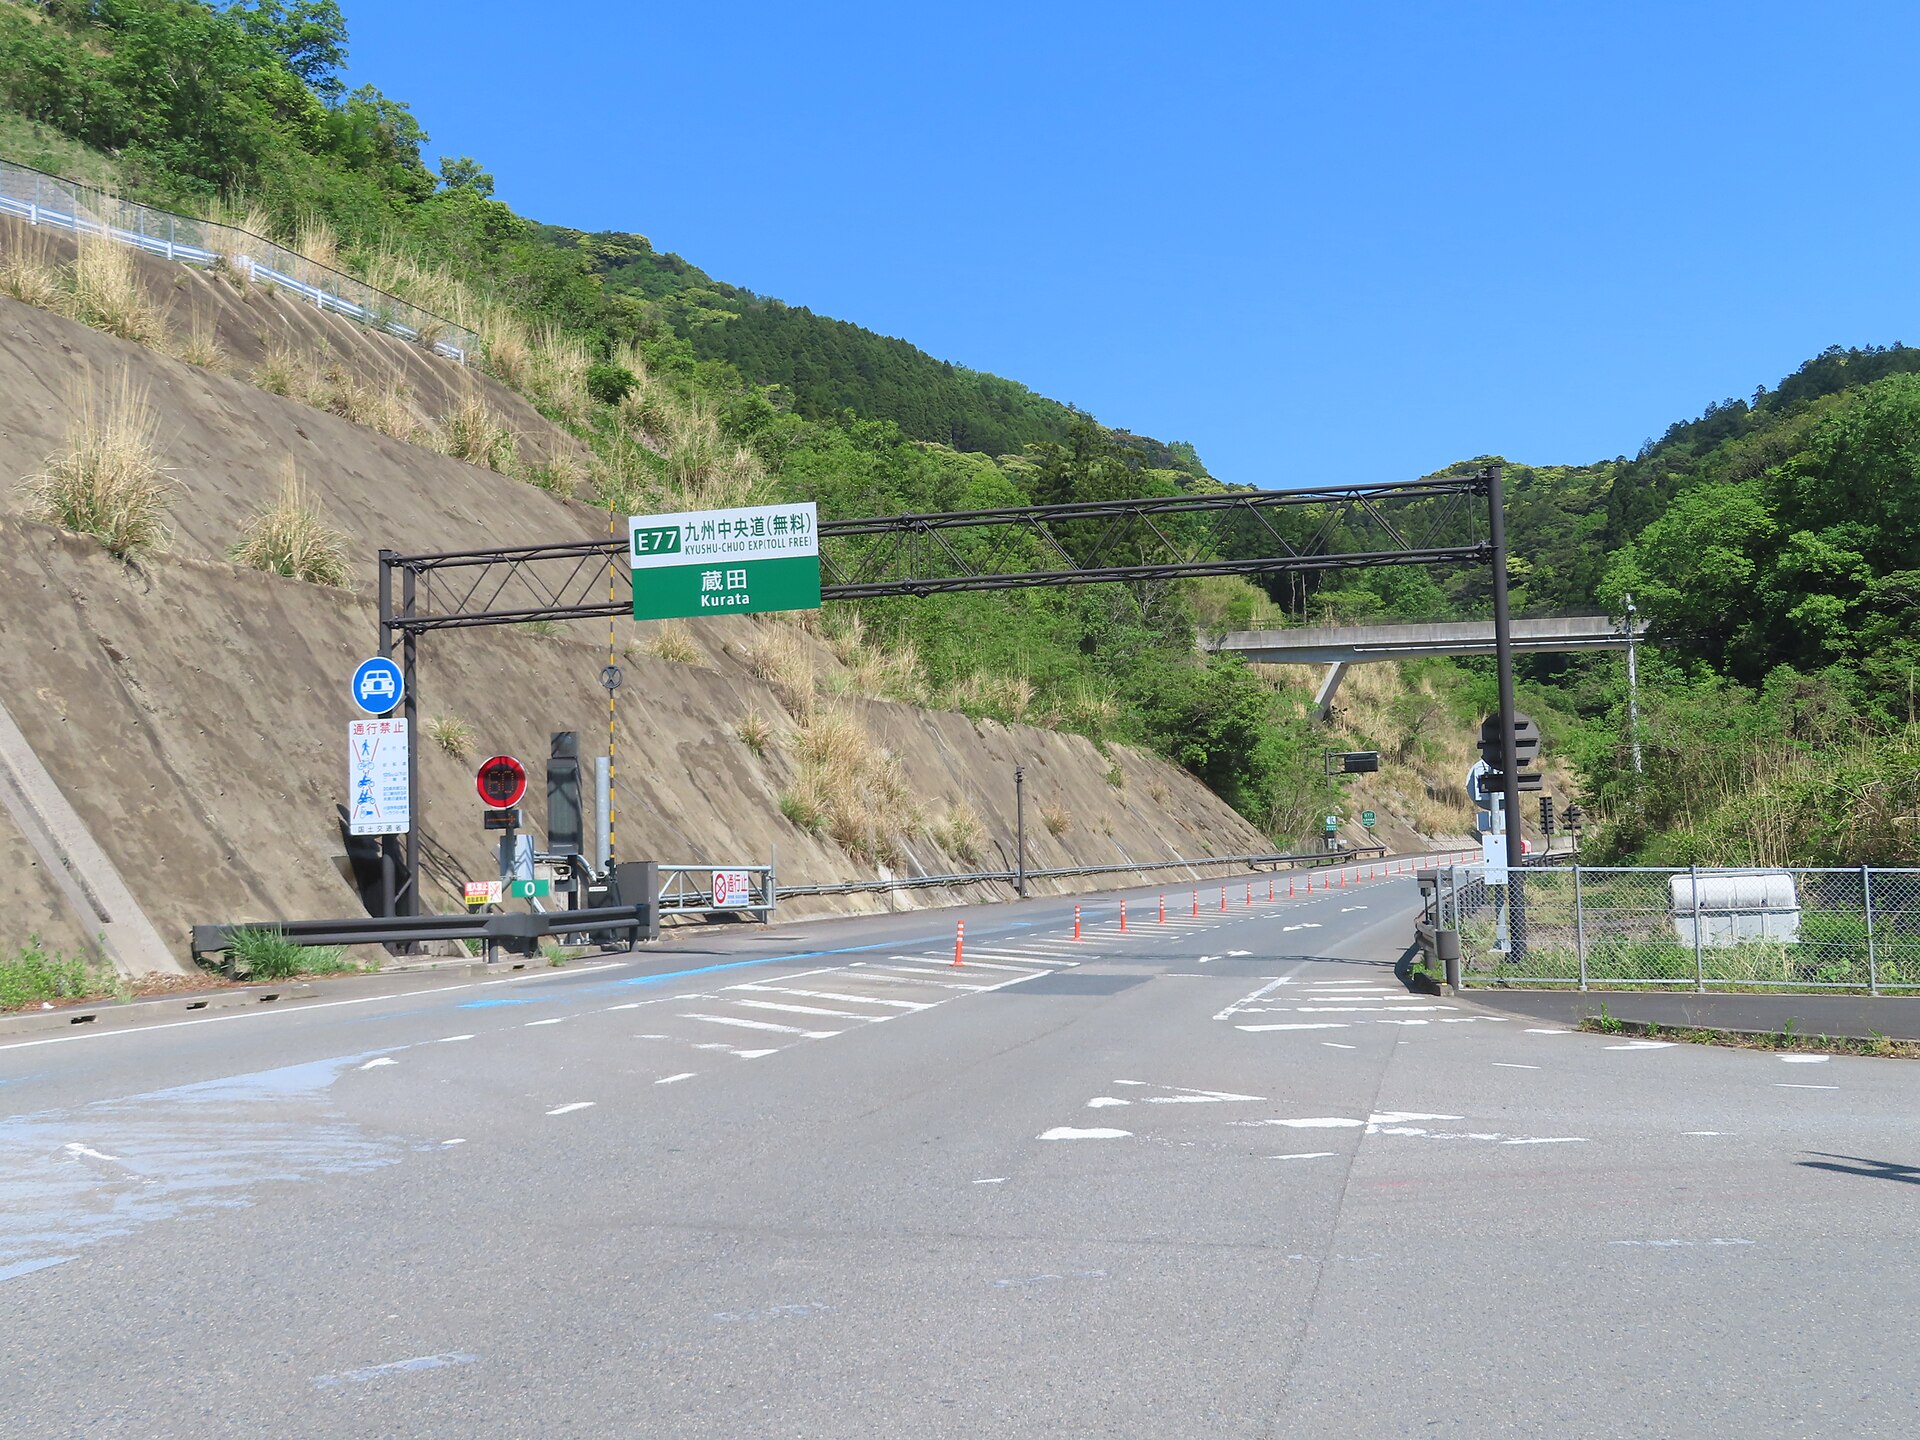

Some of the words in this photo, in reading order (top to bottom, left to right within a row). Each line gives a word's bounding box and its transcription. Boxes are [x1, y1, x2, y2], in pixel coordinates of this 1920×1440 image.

[685, 512, 811, 543] 九州中央道(無料)
[637, 531, 678, 551] E77
[685, 542, 745, 555] KYUSHU-CHUO
[748, 538, 786, 551] EXP(TOLL
[788, 536, 812, 548] FREE)
[701, 569, 748, 592] 蔵田
[701, 593, 750, 607] Kurata
[353, 721, 405, 735] 通行禁止
[524, 881, 536, 896] 0
